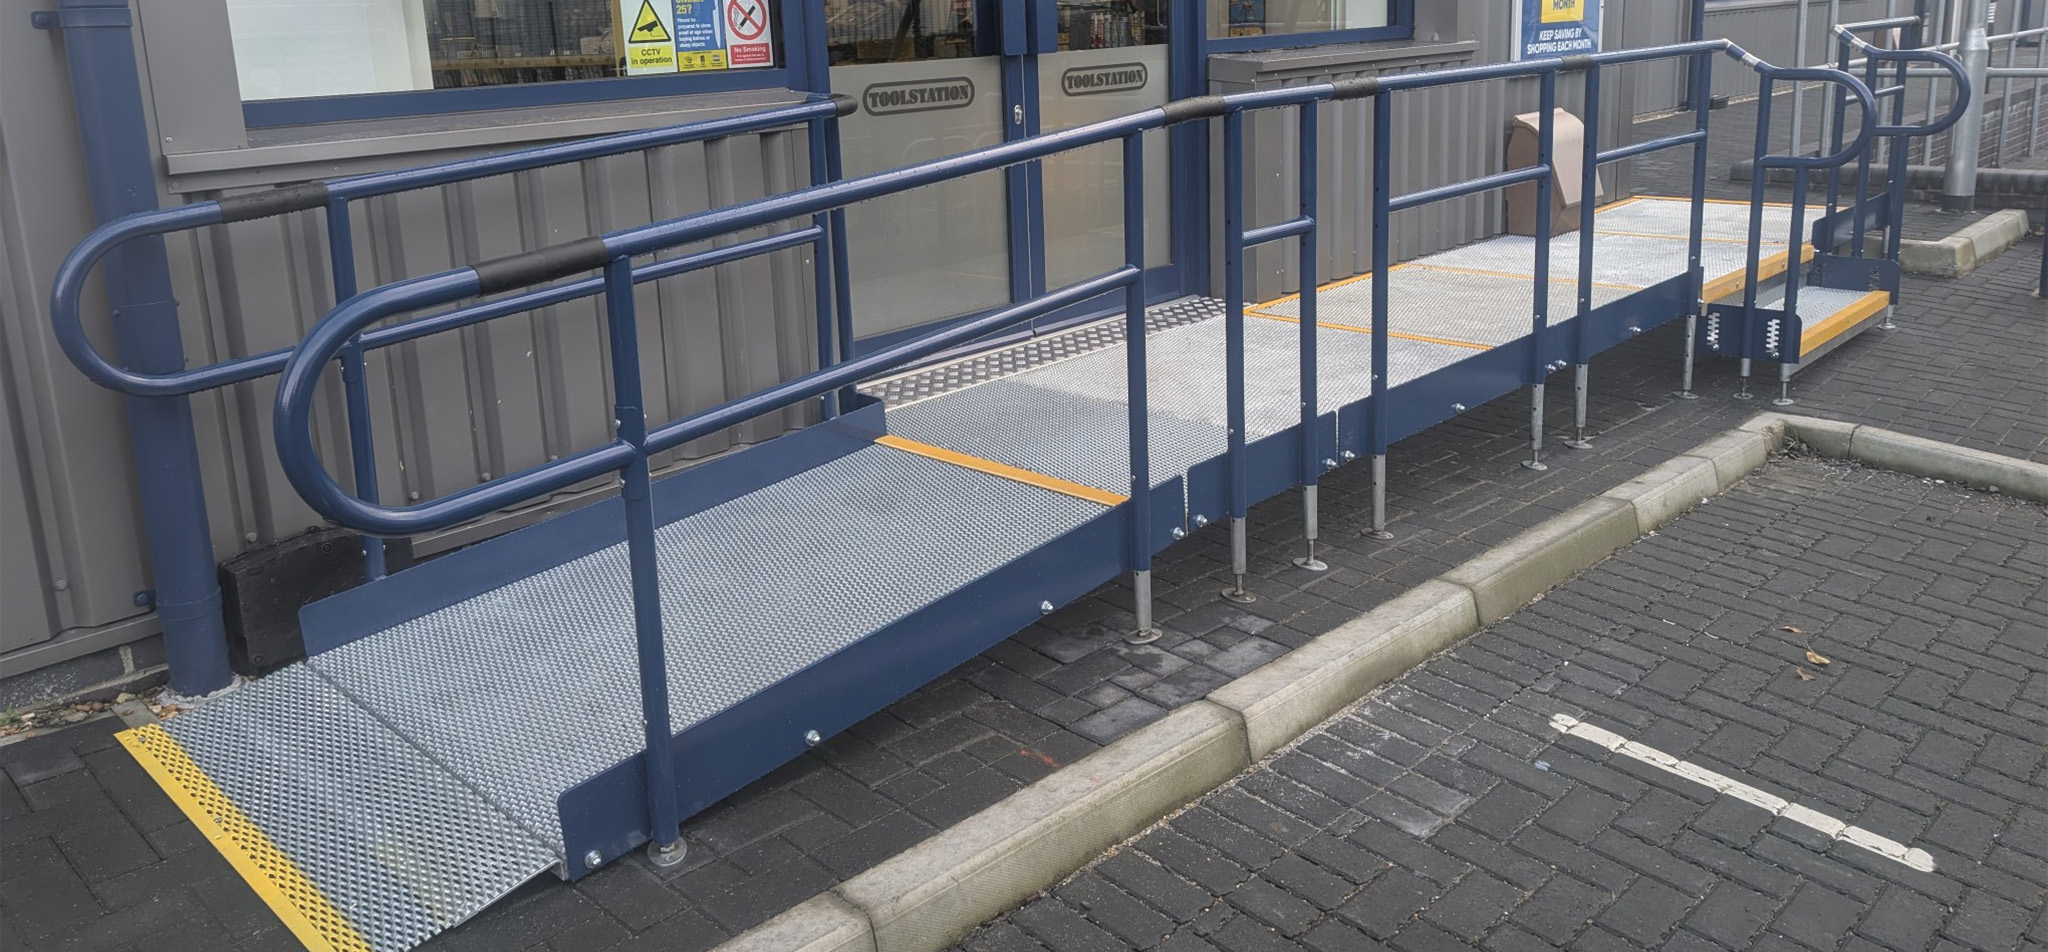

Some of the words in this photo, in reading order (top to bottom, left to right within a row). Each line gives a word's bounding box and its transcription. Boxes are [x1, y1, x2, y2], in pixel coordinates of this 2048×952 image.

[677, 4, 692, 15] 25?
[1539, 29, 1553, 41] KEEP
[1554, 28, 1574, 40] SAVING
[1575, 27, 1583, 38] BY
[641, 48, 661, 56] CCTV
[742, 45, 766, 53] Smoking
[1527, 41, 1557, 55] SHOPPING
[1557, 40, 1572, 52] EACH
[1572, 38, 1592, 50] MONTH
[631, 57, 639, 65] in
[639, 56, 673, 66] operation
[1066, 68, 1143, 89] TOOLSTATION
[868, 84, 970, 108] TOOLSTATION
